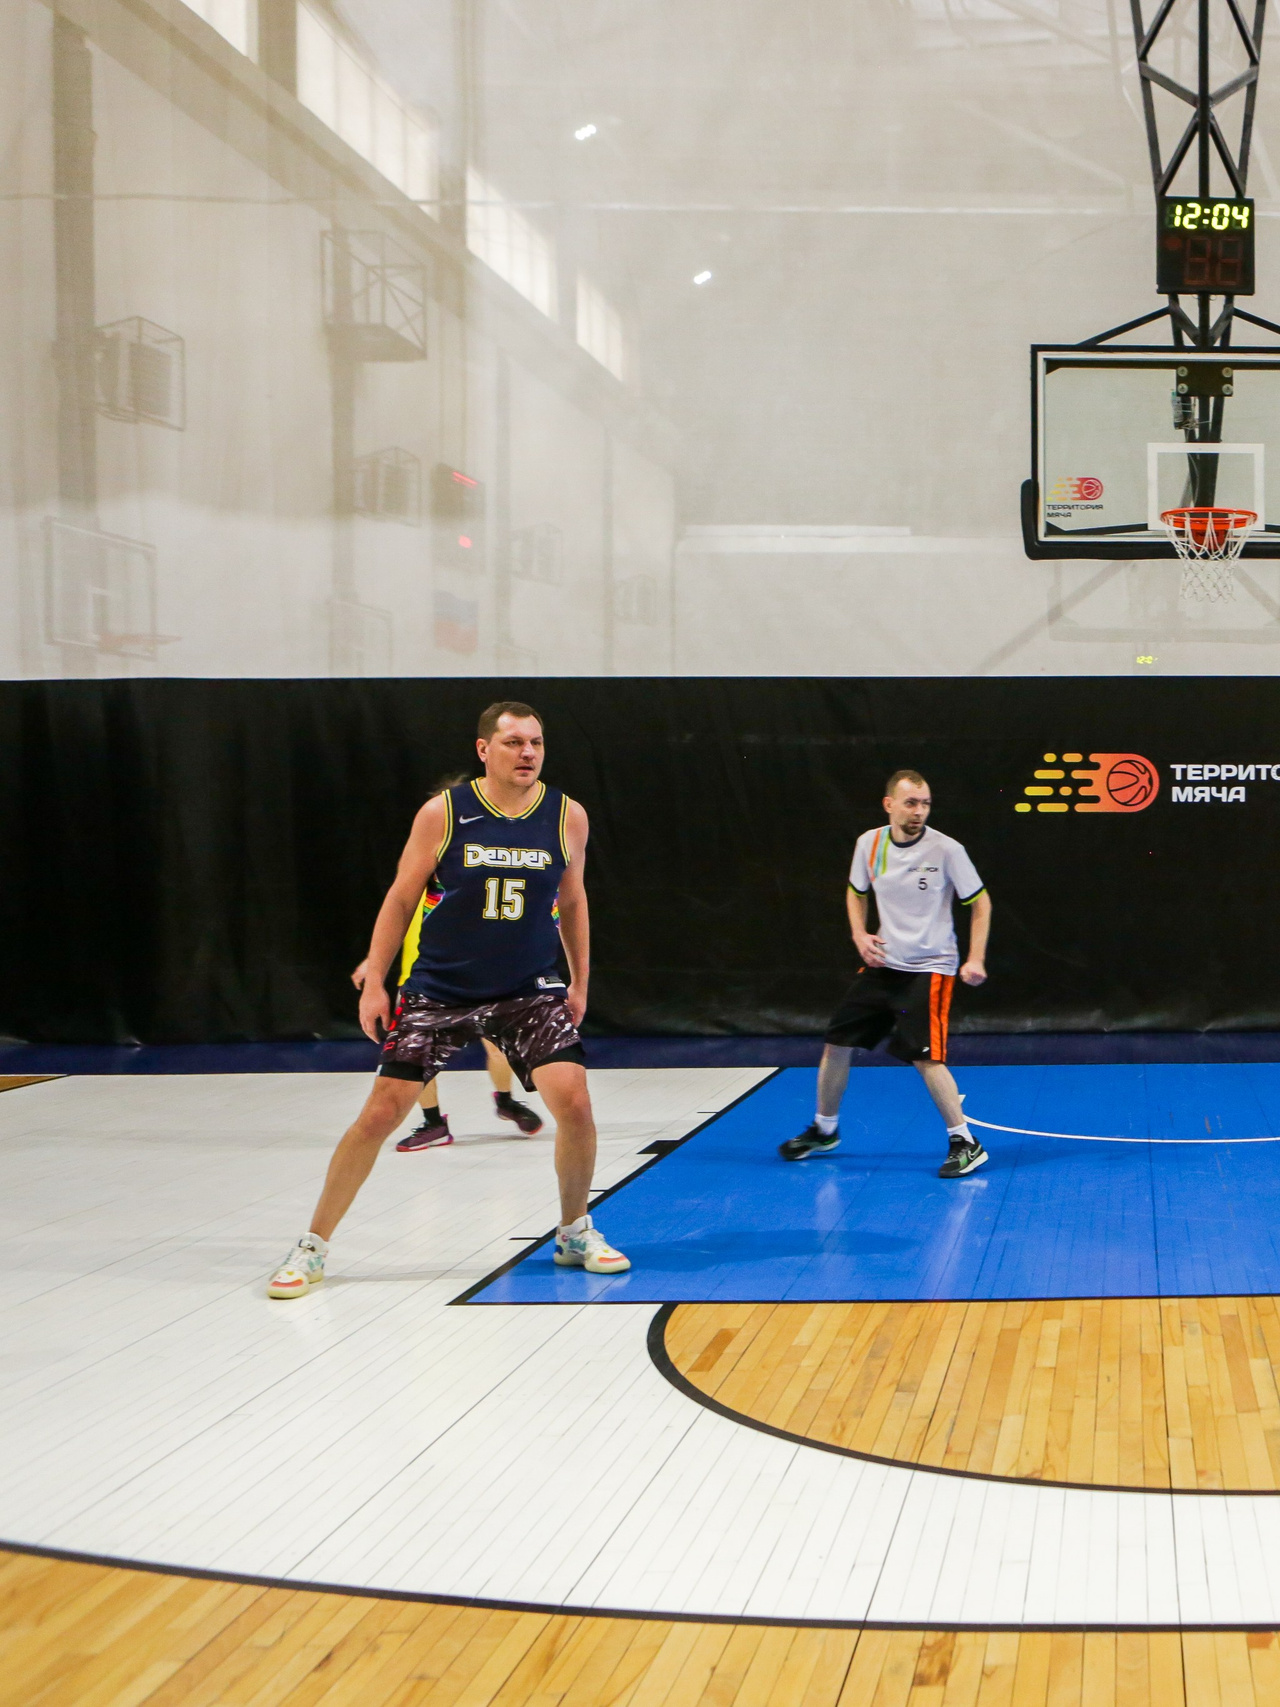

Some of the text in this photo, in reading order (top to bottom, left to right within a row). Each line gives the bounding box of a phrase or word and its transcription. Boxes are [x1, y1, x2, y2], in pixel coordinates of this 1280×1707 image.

[1173, 202, 1250, 231] 12:04
[1171, 786, 1246, 803] МЯЧА
[464, 844, 552, 869] Denver
[918, 877, 928, 890] 5
[483, 878, 525, 920] 15
